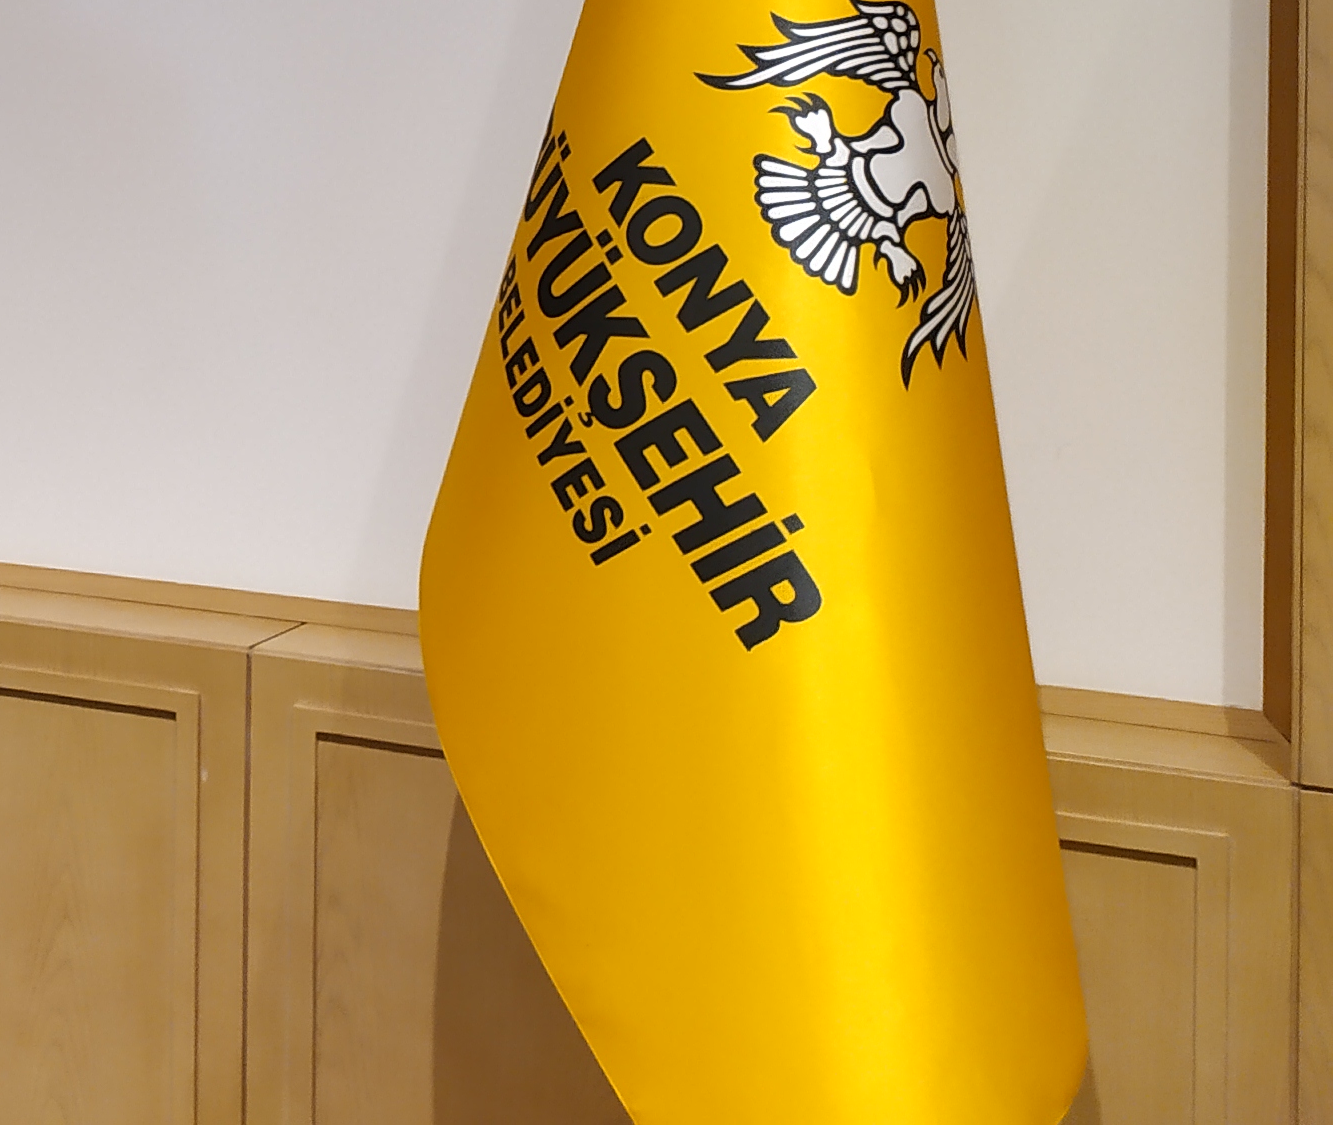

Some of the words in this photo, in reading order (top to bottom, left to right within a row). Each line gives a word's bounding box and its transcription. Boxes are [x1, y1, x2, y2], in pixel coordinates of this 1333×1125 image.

[496, 253, 652, 567] BELEDİYESİ
[524, 103, 823, 653] ÜYÜKŞEHİR
[593, 136, 818, 443] KONYA
